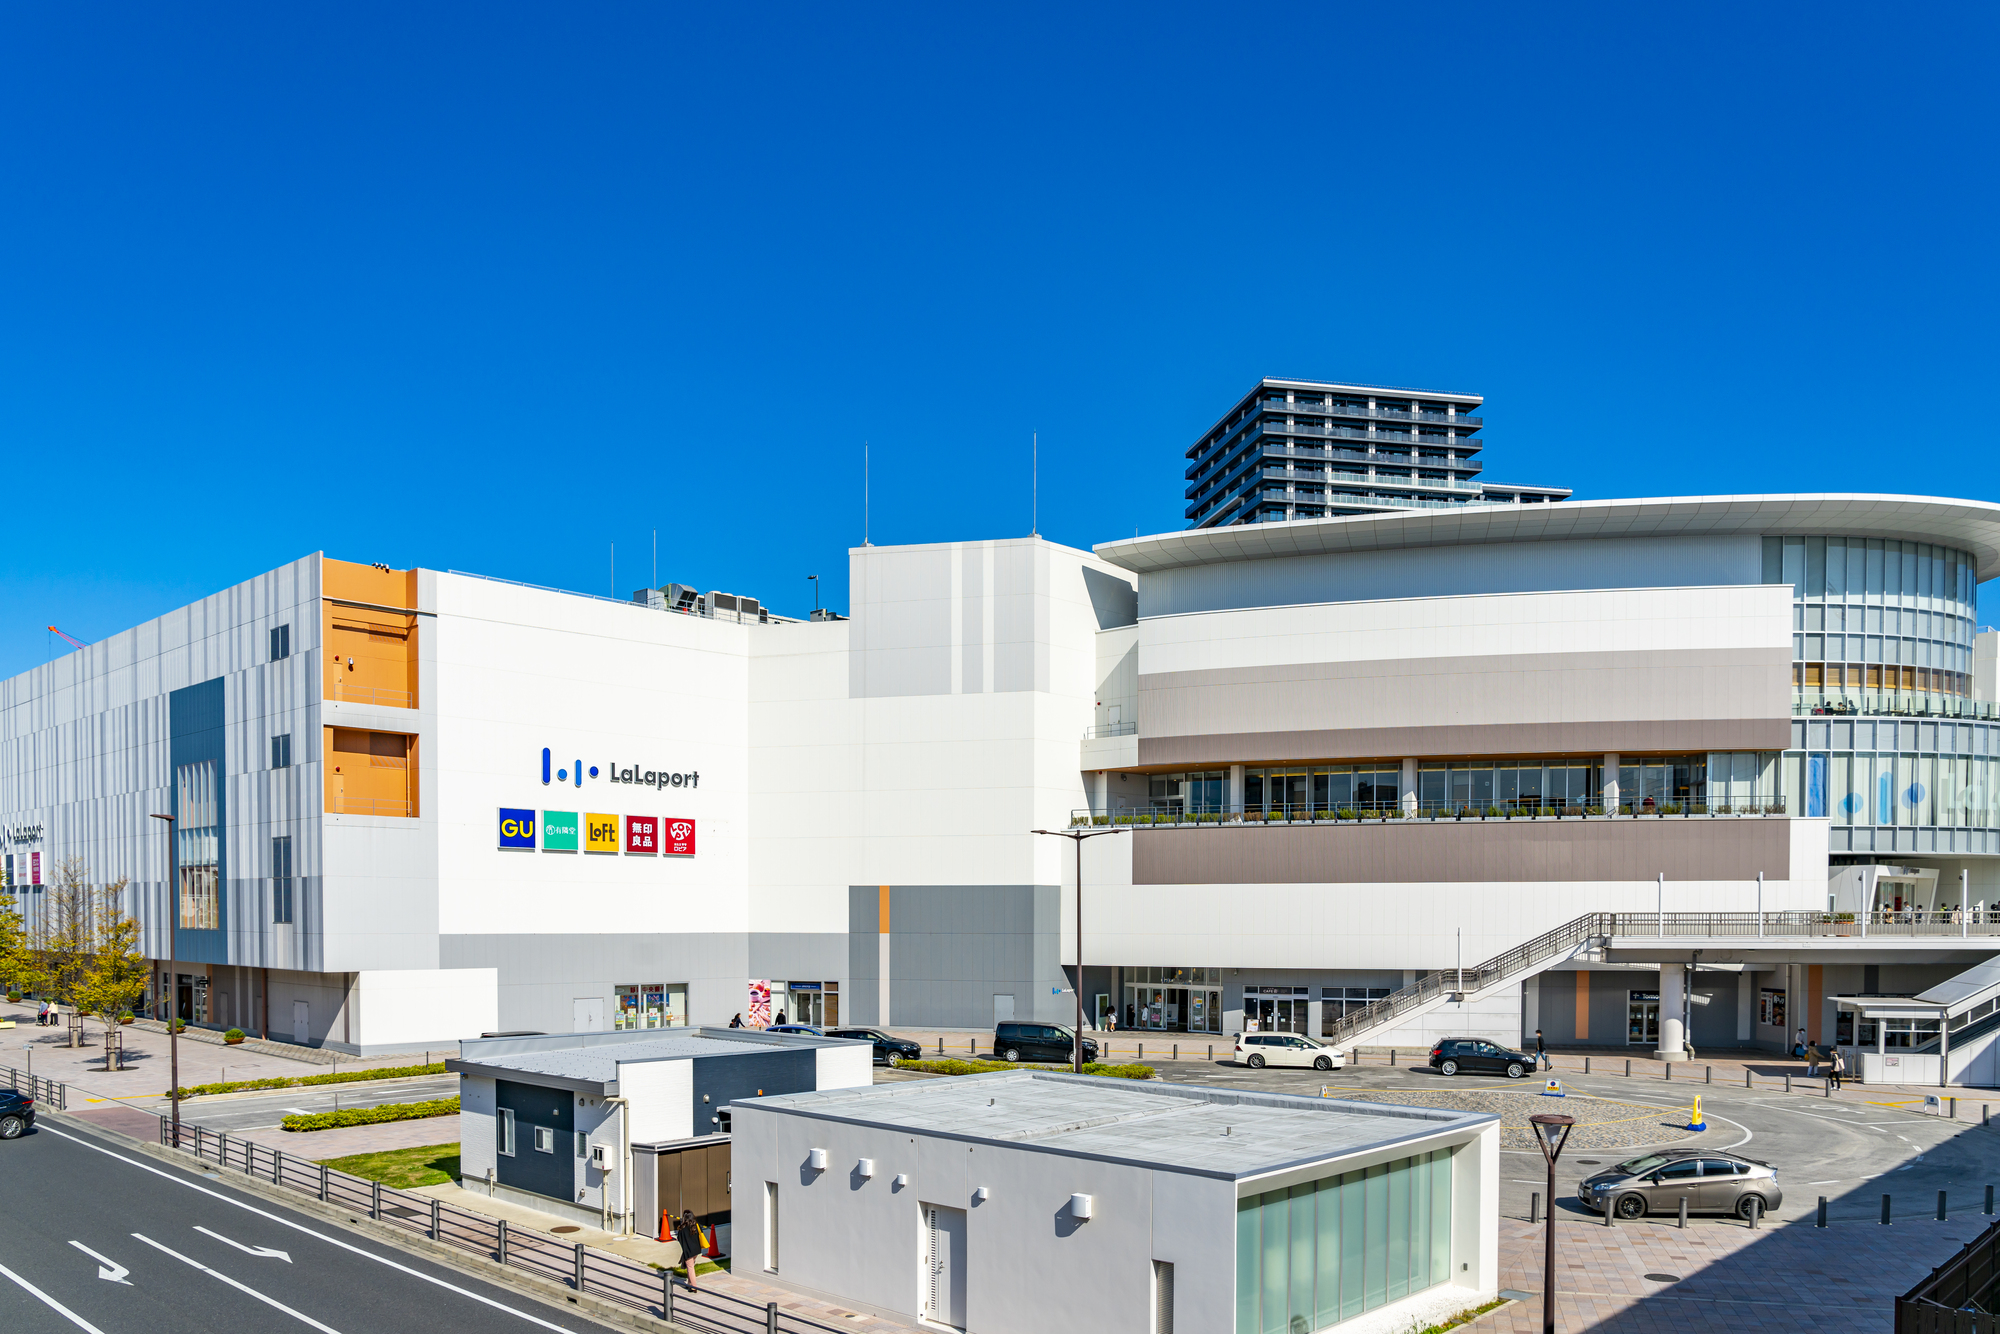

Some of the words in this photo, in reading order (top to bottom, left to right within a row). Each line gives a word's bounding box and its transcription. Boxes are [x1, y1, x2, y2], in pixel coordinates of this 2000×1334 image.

[610, 762, 699, 790] LaLaport
[501, 819, 534, 838] GU
[631, 822, 653, 834] 無印
[631, 835, 653, 847] 良品
